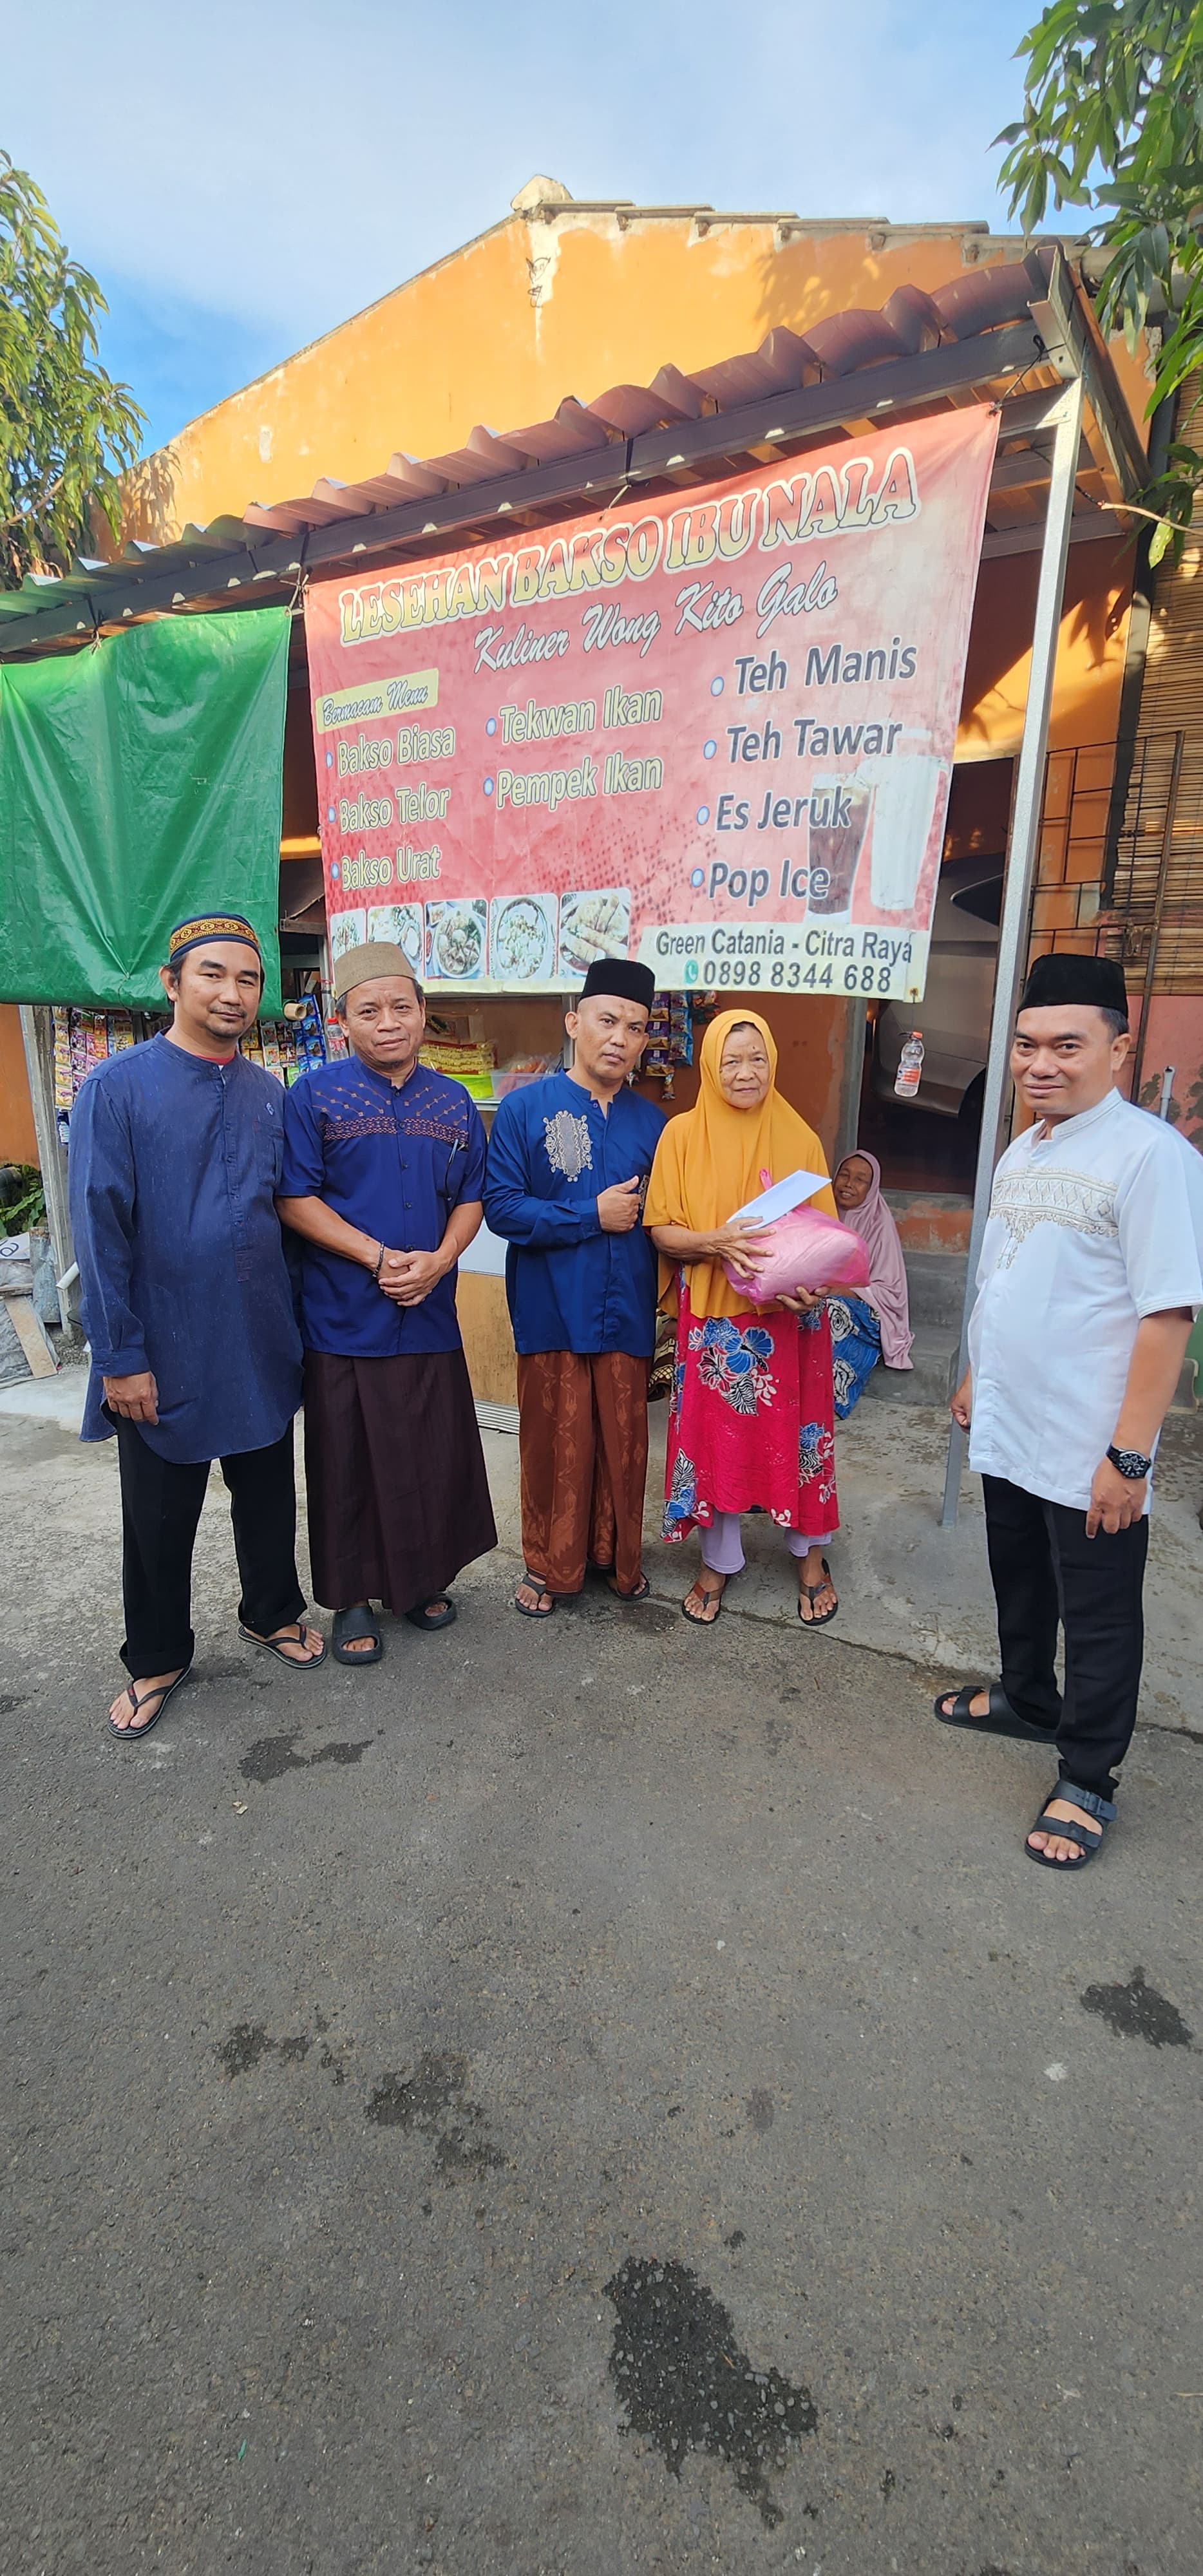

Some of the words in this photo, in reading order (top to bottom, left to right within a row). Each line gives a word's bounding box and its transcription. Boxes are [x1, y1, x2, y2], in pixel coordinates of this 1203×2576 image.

[341, 555, 511, 644] LESEHAN
[513, 520, 659, 604] BAKSO
[667, 493, 757, 569] IBU
[763, 453, 917, 547] NALA
[474, 625, 571, 674] Kuliner
[582, 603, 661, 658] Wong
[675, 582, 744, 636] Kito
[757, 560, 838, 638] Galo
[735, 651, 786, 694] Teh
[804, 637, 916, 687] Manis
[323, 695, 383, 726] Bermacam
[386, 680, 428, 711] Menu
[500, 699, 594, 744] Tekwan
[603, 685, 662, 728] Ikan
[338, 735, 392, 776] Bakso
[397, 726, 455, 764] Biasa
[727, 721, 781, 762] Teh
[794, 719, 902, 756] Tawar
[497, 757, 596, 810] Pempek
[603, 752, 662, 794] Ikan
[339, 792, 392, 833] Bakso
[397, 783, 450, 823] Telor
[716, 795, 749, 831] Es
[758, 786, 852, 829] Jeruk
[341, 851, 392, 891] Bakso
[397, 846, 440, 882] Urat
[710, 862, 768, 906] Pop
[780, 860, 829, 898] Ice
[656, 931, 705, 956] Green
[711, 929, 785, 956] Catania
[804, 929, 854, 958] Citra
[862, 931, 913, 967] Raya
[704, 961, 760, 986] 0898
[772, 961, 833, 988] 8344
[844, 965, 891, 992] 688
